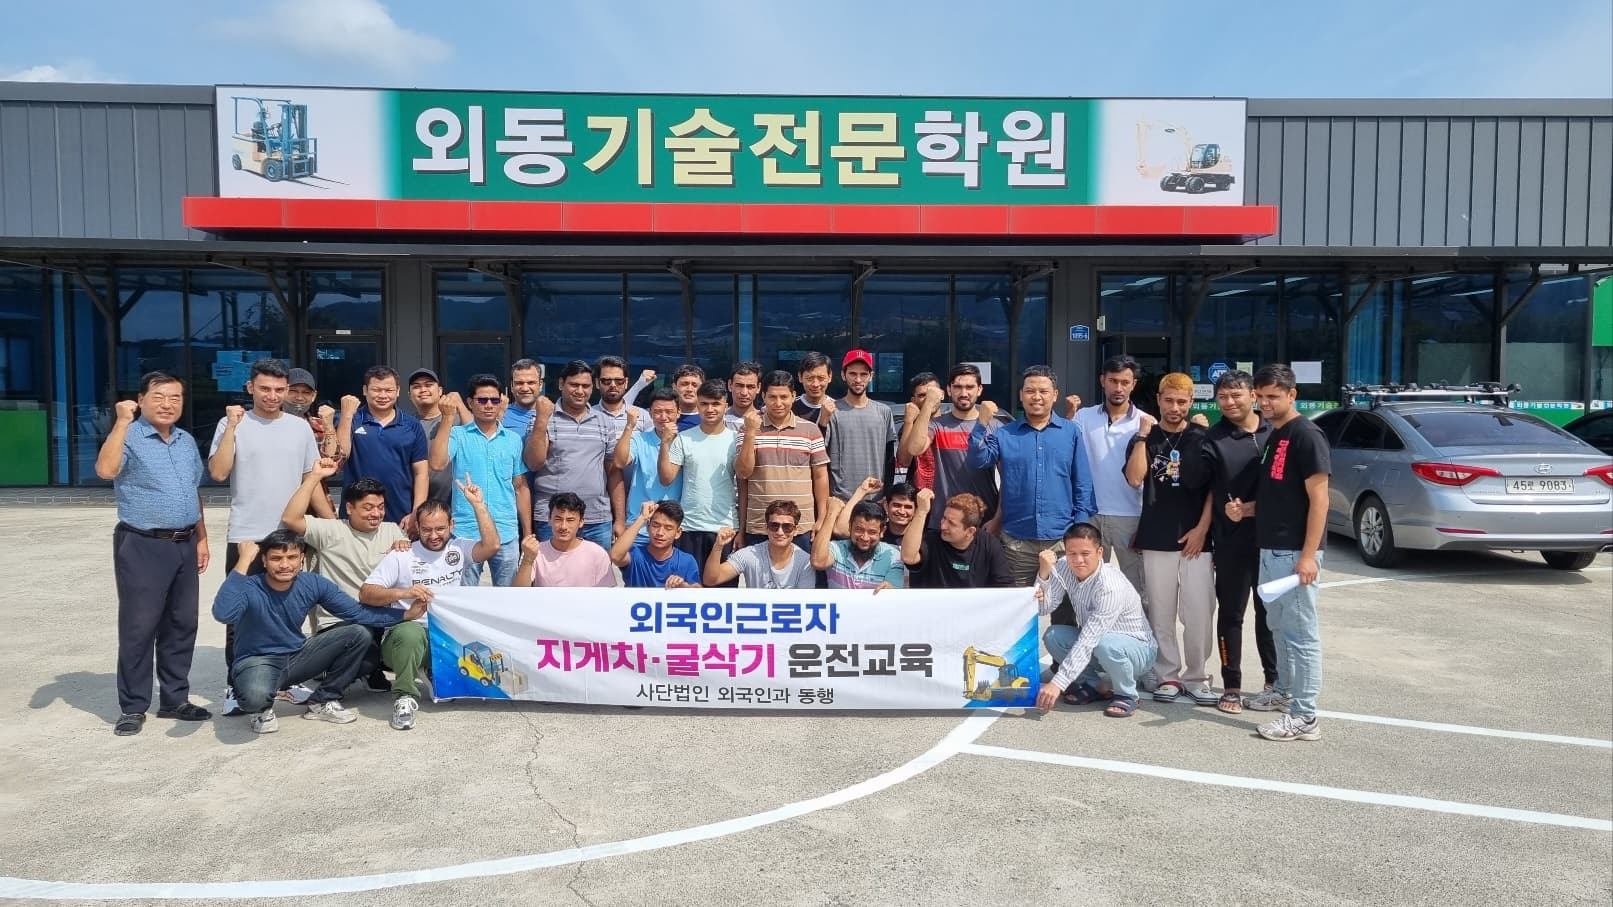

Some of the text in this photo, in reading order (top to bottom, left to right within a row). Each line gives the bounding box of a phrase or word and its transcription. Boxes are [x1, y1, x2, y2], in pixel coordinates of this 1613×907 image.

[412, 105, 1067, 188] 외동기술전문학원
[1539, 480, 1567, 491] 9083
[412, 568, 463, 586] PENALTY
[629, 602, 840, 634] 외국인근로자
[787, 643, 934, 678] 운전교육
[636, 683, 834, 705] 사단법인 외국인과 동행
